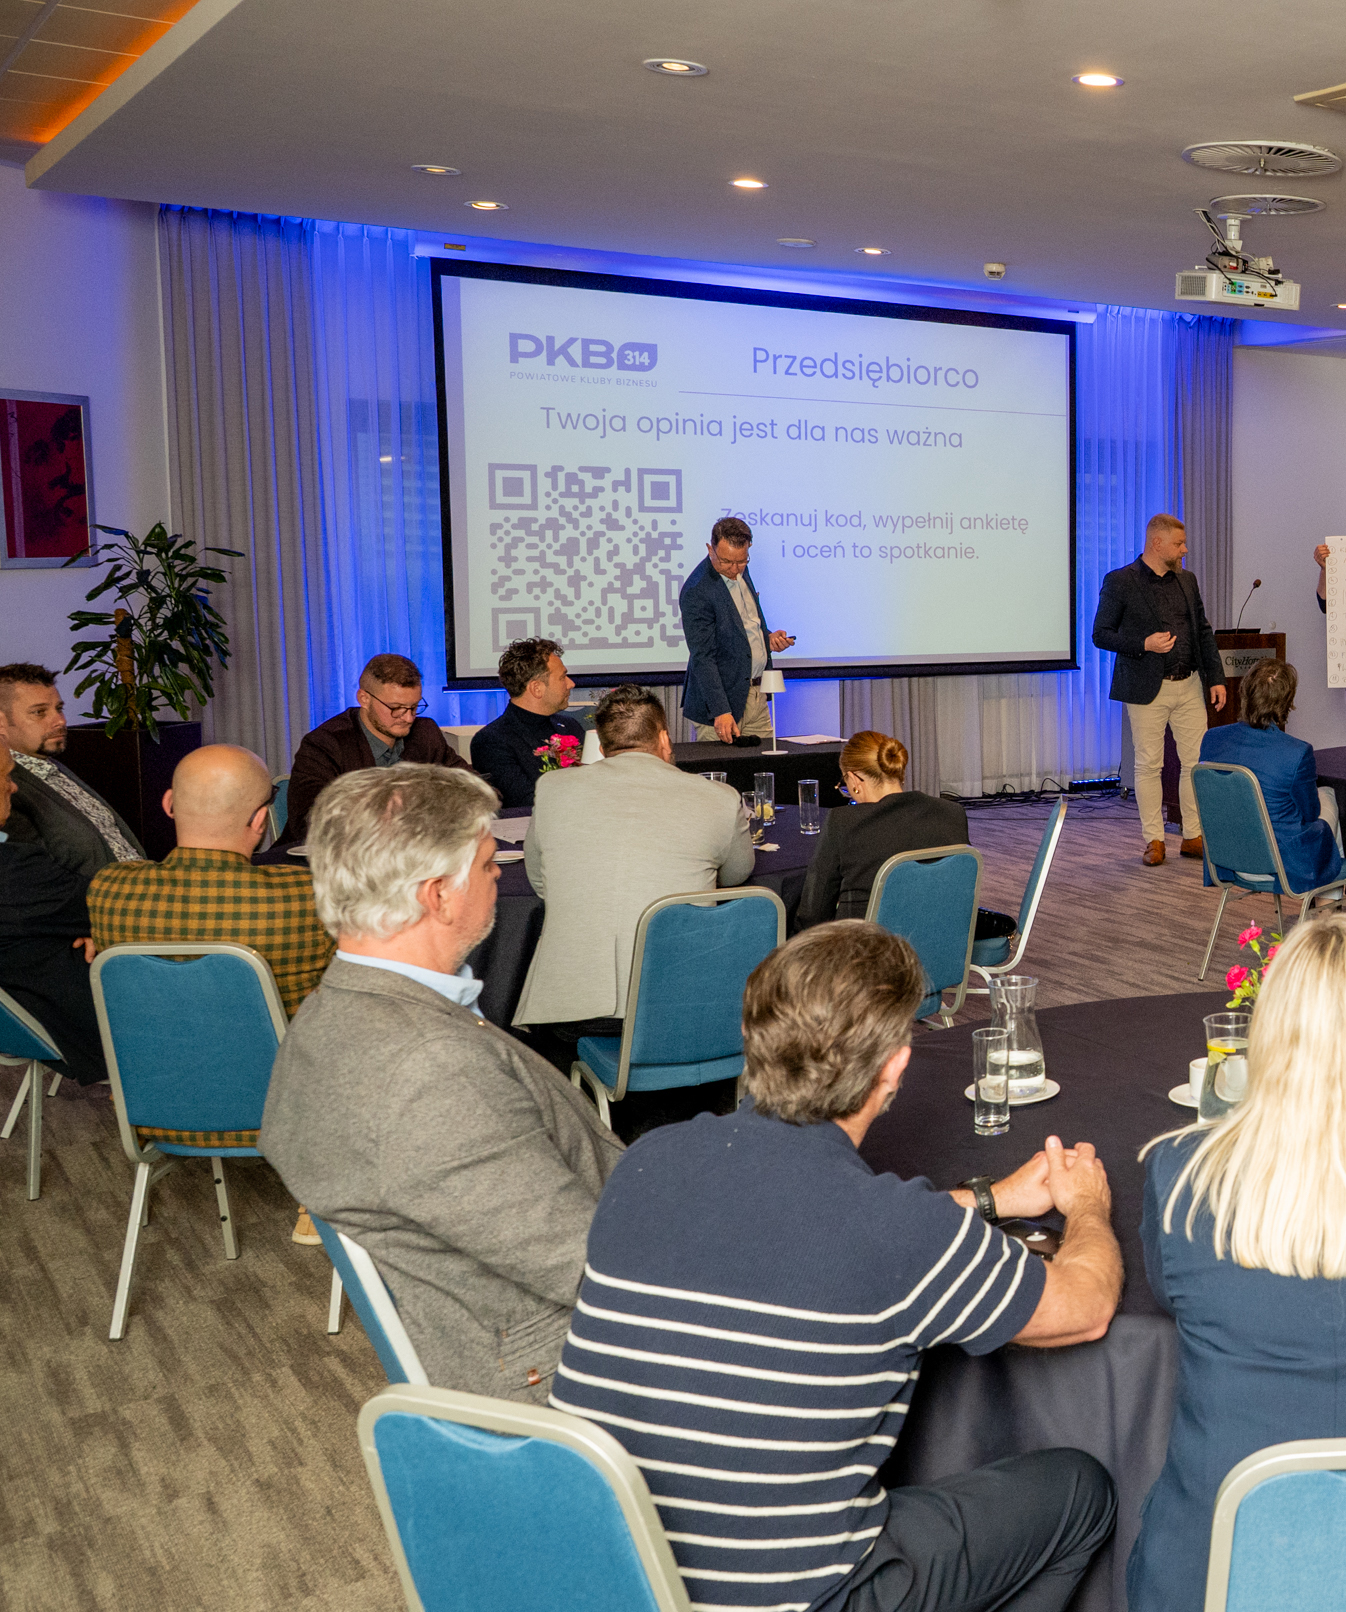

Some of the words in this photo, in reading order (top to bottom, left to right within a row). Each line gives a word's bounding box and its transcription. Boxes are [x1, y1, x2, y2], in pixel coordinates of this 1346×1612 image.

[509, 332, 615, 370] PKB
[623, 350, 650, 366] 314
[509, 371, 576, 383] POWIATOWE
[580, 376, 612, 385] KLUBY
[616, 377, 658, 388] BIZNESU
[752, 346, 979, 389] Przedsiębiorco
[540, 406, 627, 439] Twoja
[636, 411, 723, 441] opinia
[730, 414, 778, 445] jest
[786, 418, 825, 442] dla
[835, 425, 879, 444] nas
[886, 426, 963, 449] ważna
[824, 509, 867, 531] kod,
[872, 511, 954, 535] wypełnij
[959, 513, 1029, 535] ankietę
[781, 539, 786, 558] i
[792, 540, 846, 558] oceń
[851, 542, 873, 559] to
[878, 541, 980, 565] spotkanie.
